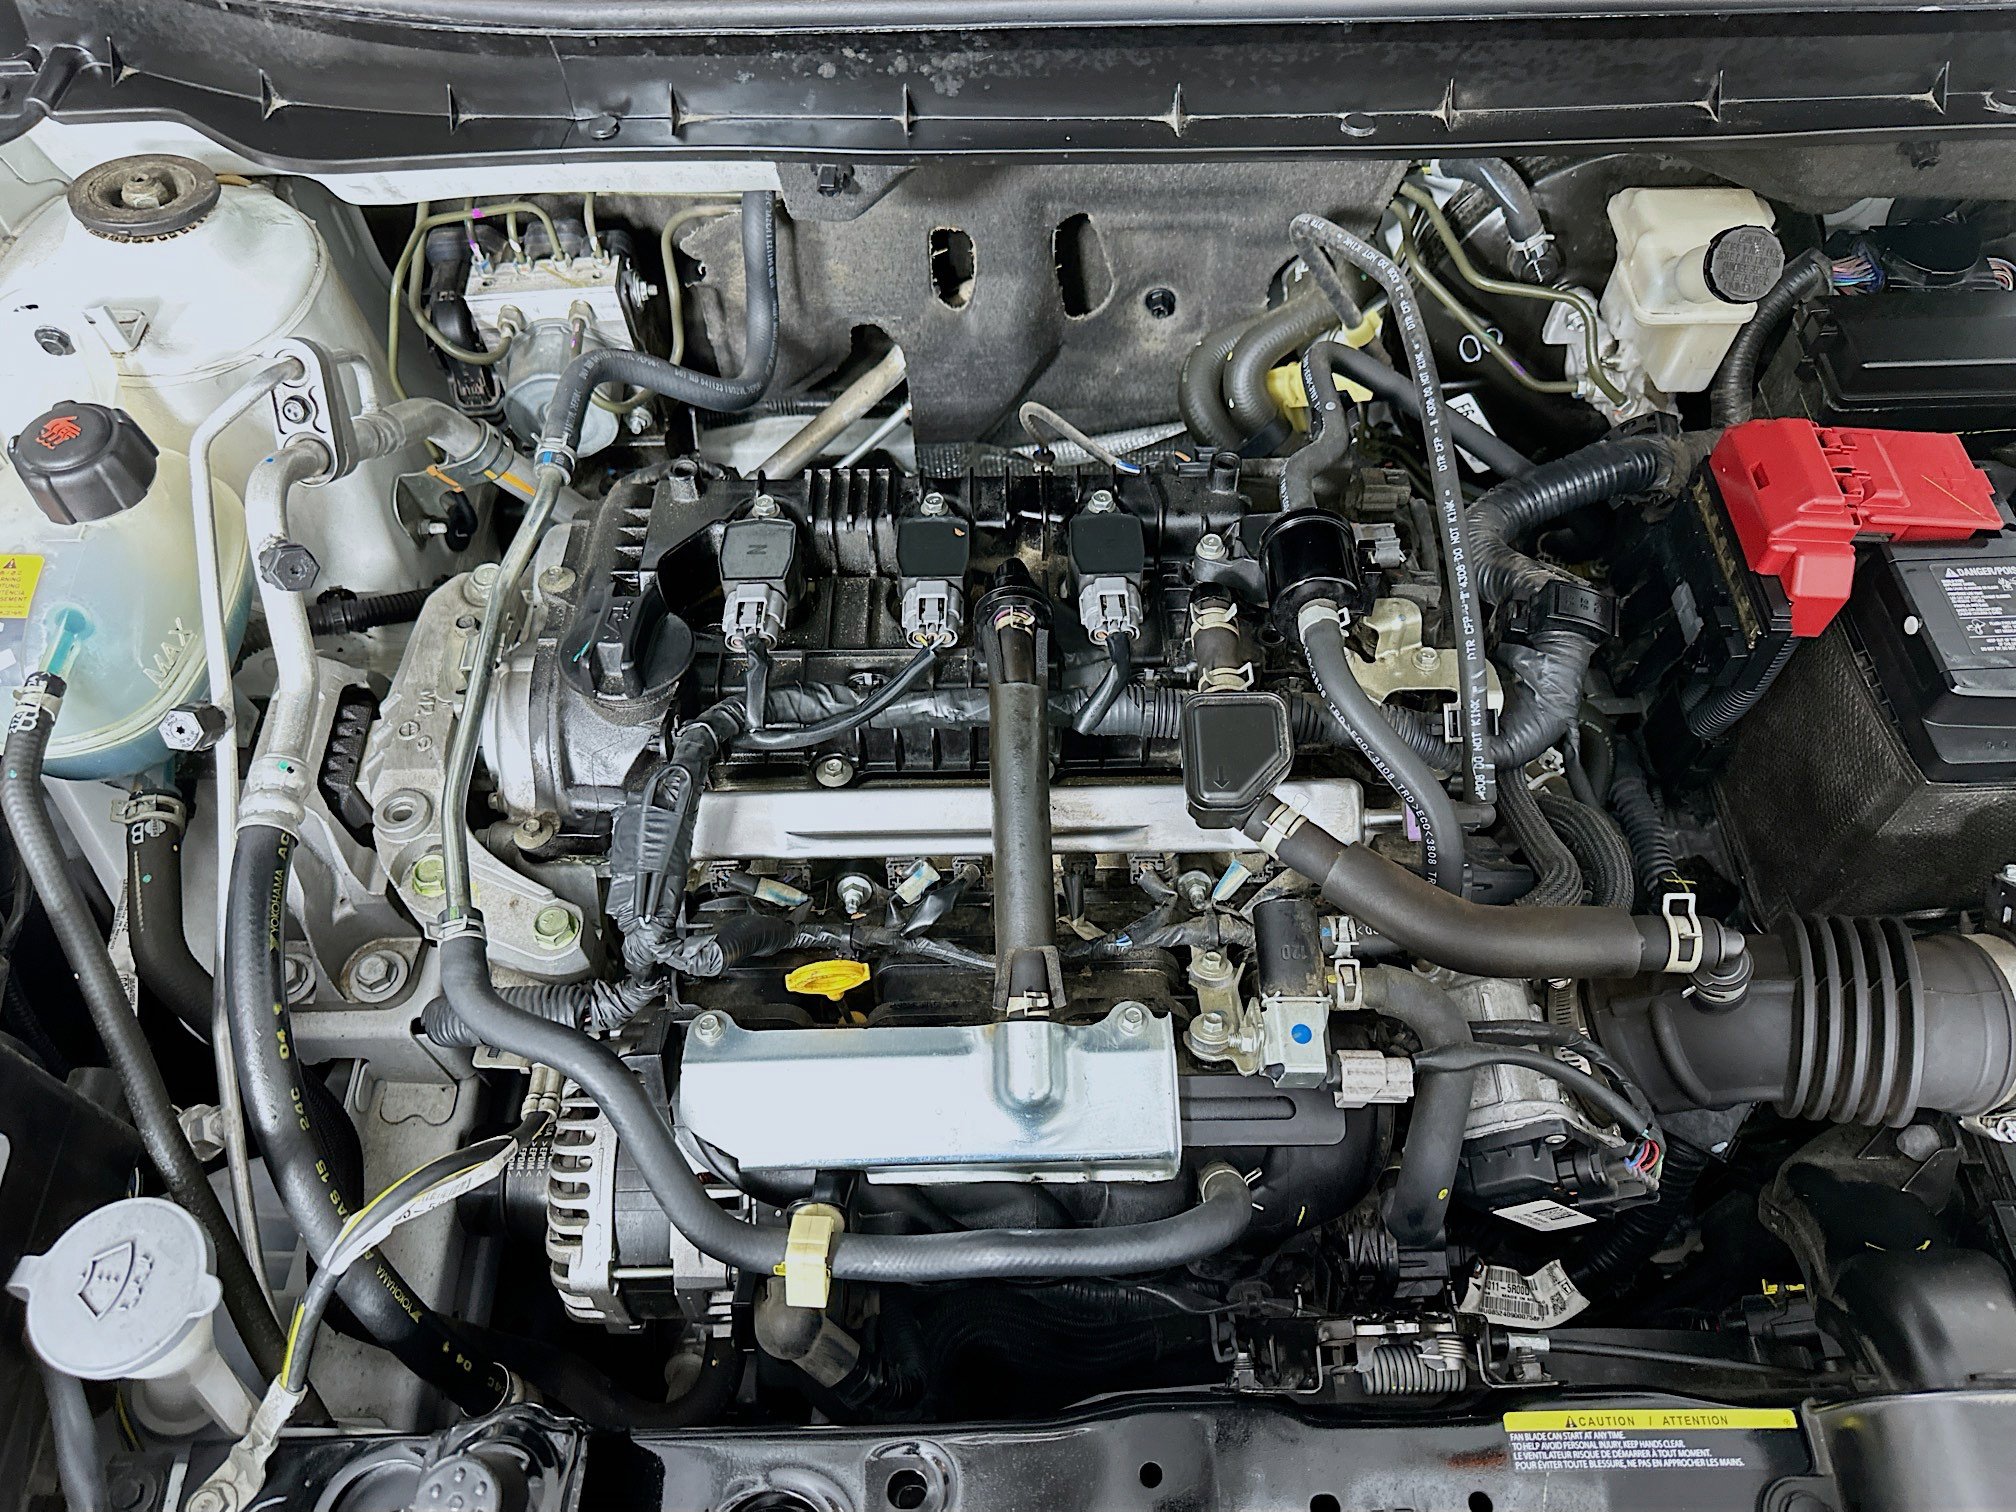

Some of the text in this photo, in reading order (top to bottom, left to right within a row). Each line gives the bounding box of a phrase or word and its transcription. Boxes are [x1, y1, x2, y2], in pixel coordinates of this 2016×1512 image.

[1418, 371, 1428, 386] NOT
[1436, 454, 1447, 472] DTR
[1449, 526, 1461, 546] NOT
[143, 617, 194, 689] MAX
[1466, 639, 1477, 660] DTR
[1471, 699, 1481, 726] KINK
[1473, 732, 1483, 751] NOT
[269, 869, 284, 933] YOKOHAMA
[376, 1264, 413, 1314] YOKOHAMA
[1578, 1416, 1635, 1427] CAUTION
[1662, 1415, 1729, 1426] ATTENTION
[1510, 1433, 1525, 1441] FAN
[1525, 1432, 1547, 1441] BLADE
[1547, 1432, 1562, 1440] CAN
[1563, 1432, 1583, 1440] START
[1584, 1431, 1593, 1440] AT
[1512, 1442, 1523, 1451] TO
[1523, 1442, 1540, 1450] HELP
[1541, 1442, 1563, 1450] AVOID
[1563, 1441, 1598, 1450] PERSONAL
[1623, 1440, 1639, 1448] KEEP
[1640, 1440, 1663, 1448] HANDS
[1513, 1452, 1523, 1460] LE
[1523, 1451, 1572, 1460] VENTILATEUR
[1573, 1451, 1600, 1459] RISQUE
[1601, 1450, 1612, 1458] DE
[1659, 1449, 1677, 1457] TOUT
[1678, 1448, 1713, 1457] MOMENT.
[1515, 1461, 1537, 1470] POUR
[1538, 1460, 1564, 1469] ÉVITER
[1564, 1460, 1588, 1469] TOUTE
[1627, 1459, 1639, 1467] NE
[1639, 1459, 1652, 1468] PAS
[1652, 1459, 1663, 1467] EN
[1663, 1458, 1706, 1467] APPROCHER
[1707, 1458, 1719, 1466] LES
[1719, 1458, 1746, 1467] MAINS.
